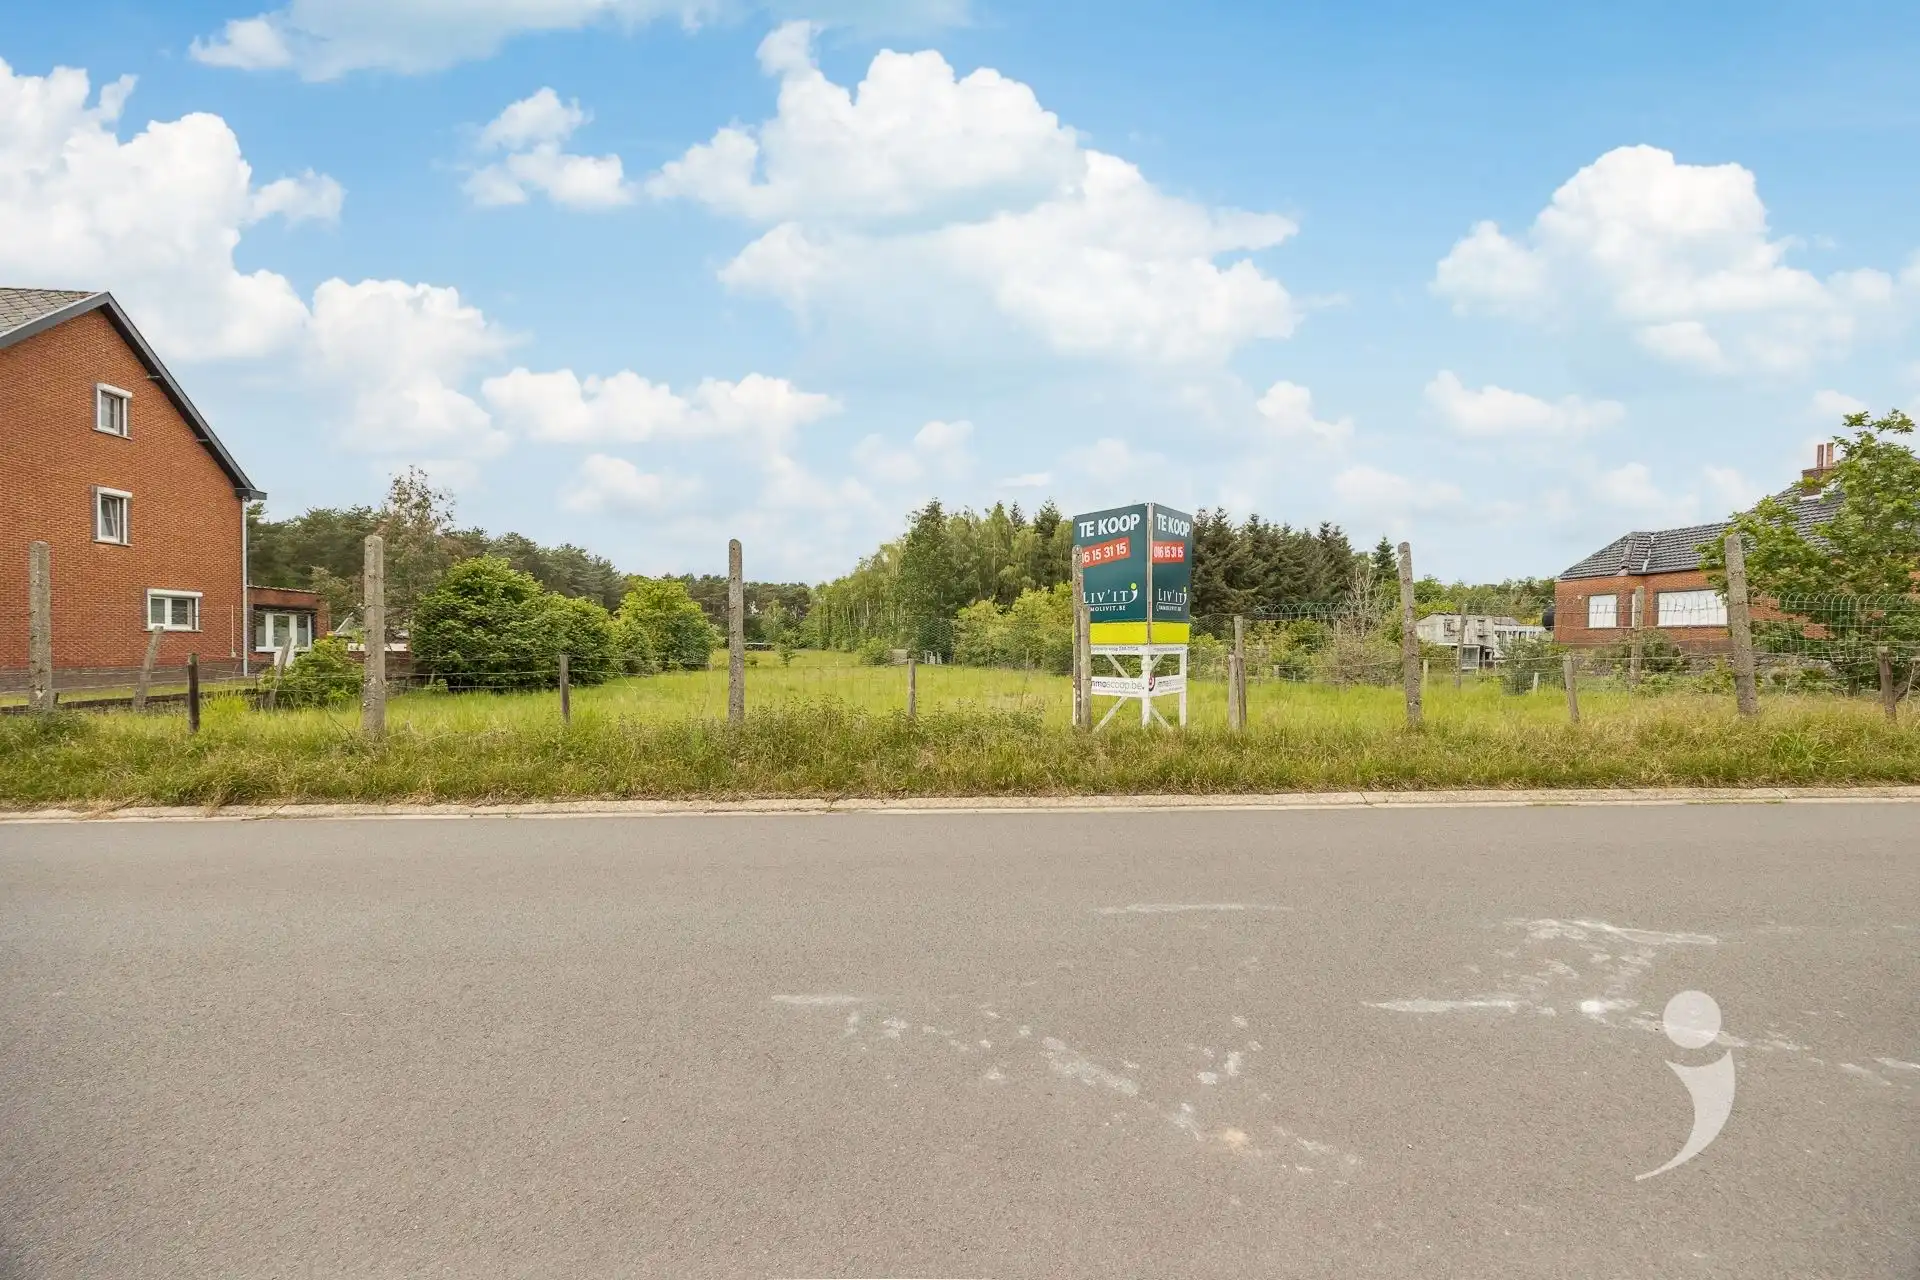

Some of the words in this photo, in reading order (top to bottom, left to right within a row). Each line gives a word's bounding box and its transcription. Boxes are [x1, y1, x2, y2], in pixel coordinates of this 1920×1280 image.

[1079, 521, 1094, 537] TE
[1098, 513, 1140, 535] KOOP
[1157, 513, 1167, 531] TE
[1168, 516, 1190, 537] KOOP
[1081, 551, 1090, 564] 16
[1091, 548, 1102, 561] 15
[1103, 545, 1114, 558] 31
[1116, 542, 1127, 556] 15
